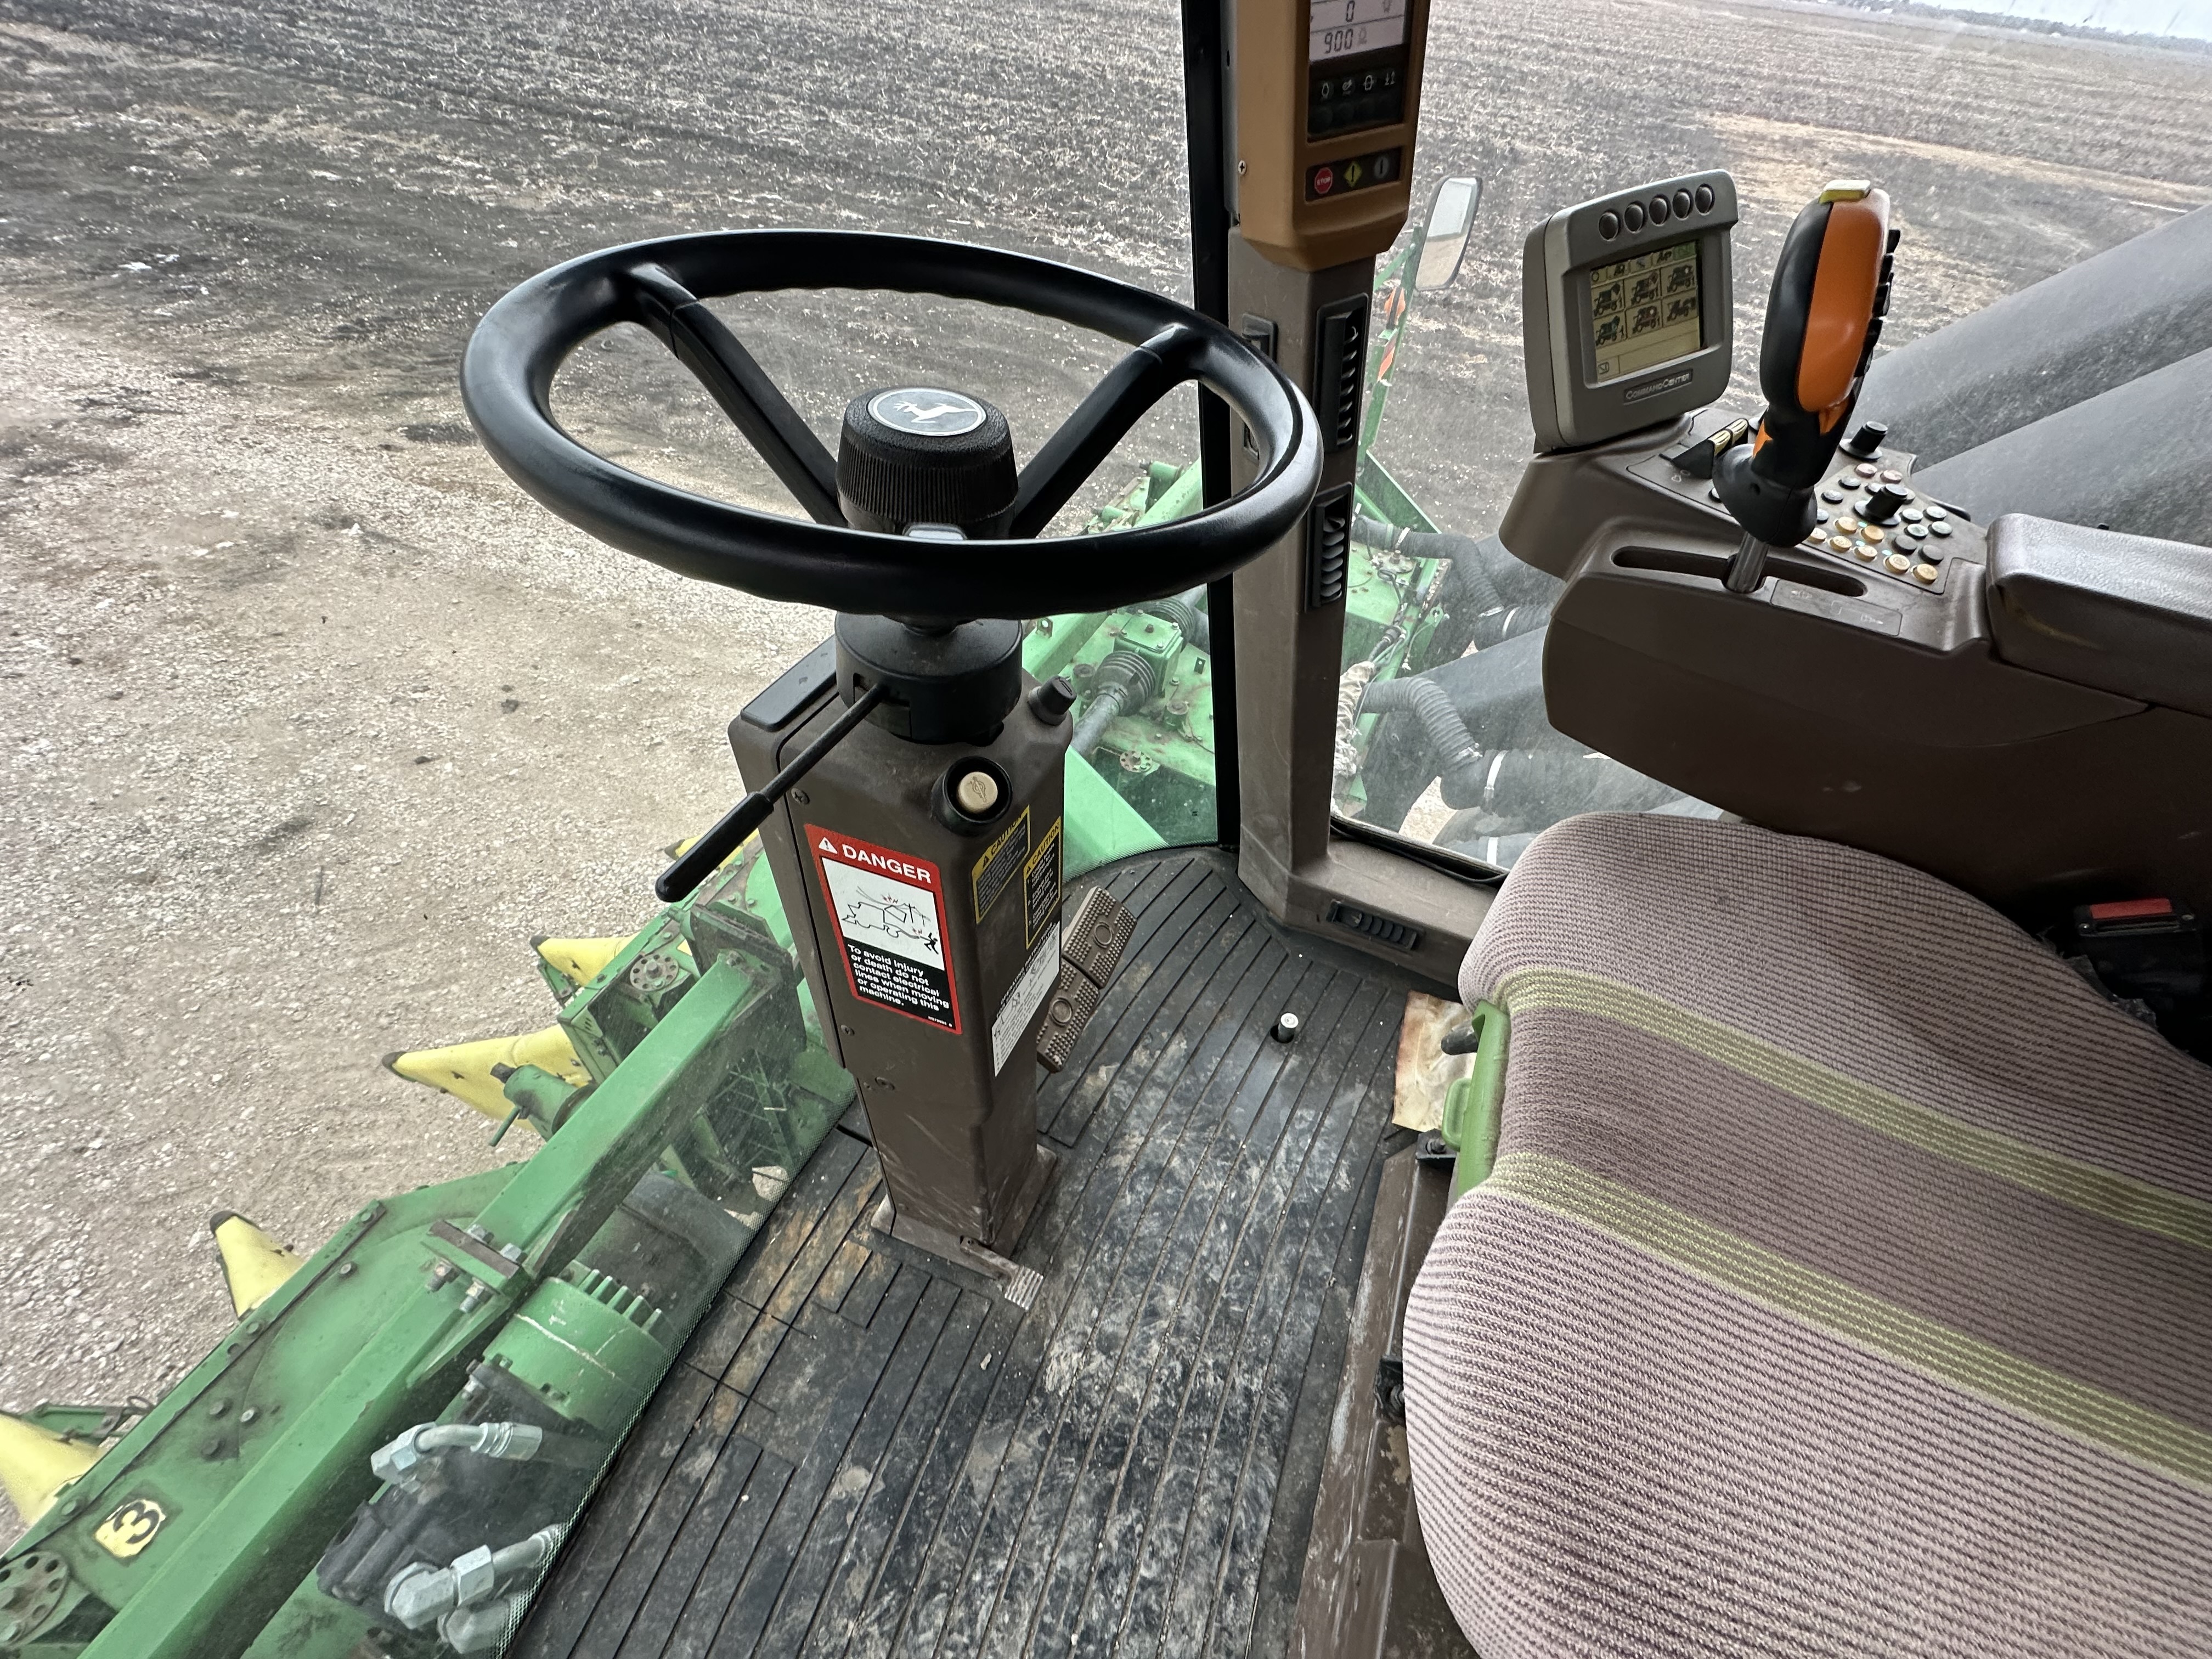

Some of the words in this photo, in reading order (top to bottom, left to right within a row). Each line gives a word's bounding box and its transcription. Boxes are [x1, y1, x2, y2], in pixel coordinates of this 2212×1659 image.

[1346, 1, 1355, 22] 0
[1324, 29, 1353, 54] 900
[1032, 822, 1059, 865] CAUTION
[842, 844, 932, 884] DANGER
[848, 944, 861, 955] To
[864, 951, 891, 966] avoid
[894, 960, 924, 977] injury
[851, 954, 861, 962] or
[864, 957, 893, 973] death
[895, 969, 909, 979] do
[911, 975, 929, 986] not
[853, 962, 891, 980] contact
[893, 976, 939, 997] electrical
[855, 968, 879, 983] lines
[881, 979, 909, 993] when
[911, 989, 950, 1009] moving
[857, 978, 868, 986] or
[870, 982, 918, 1005] operating
[919, 998, 939, 1011] this
[859, 985, 904, 1006] machine.
[112, 1501, 161, 1544] 3
